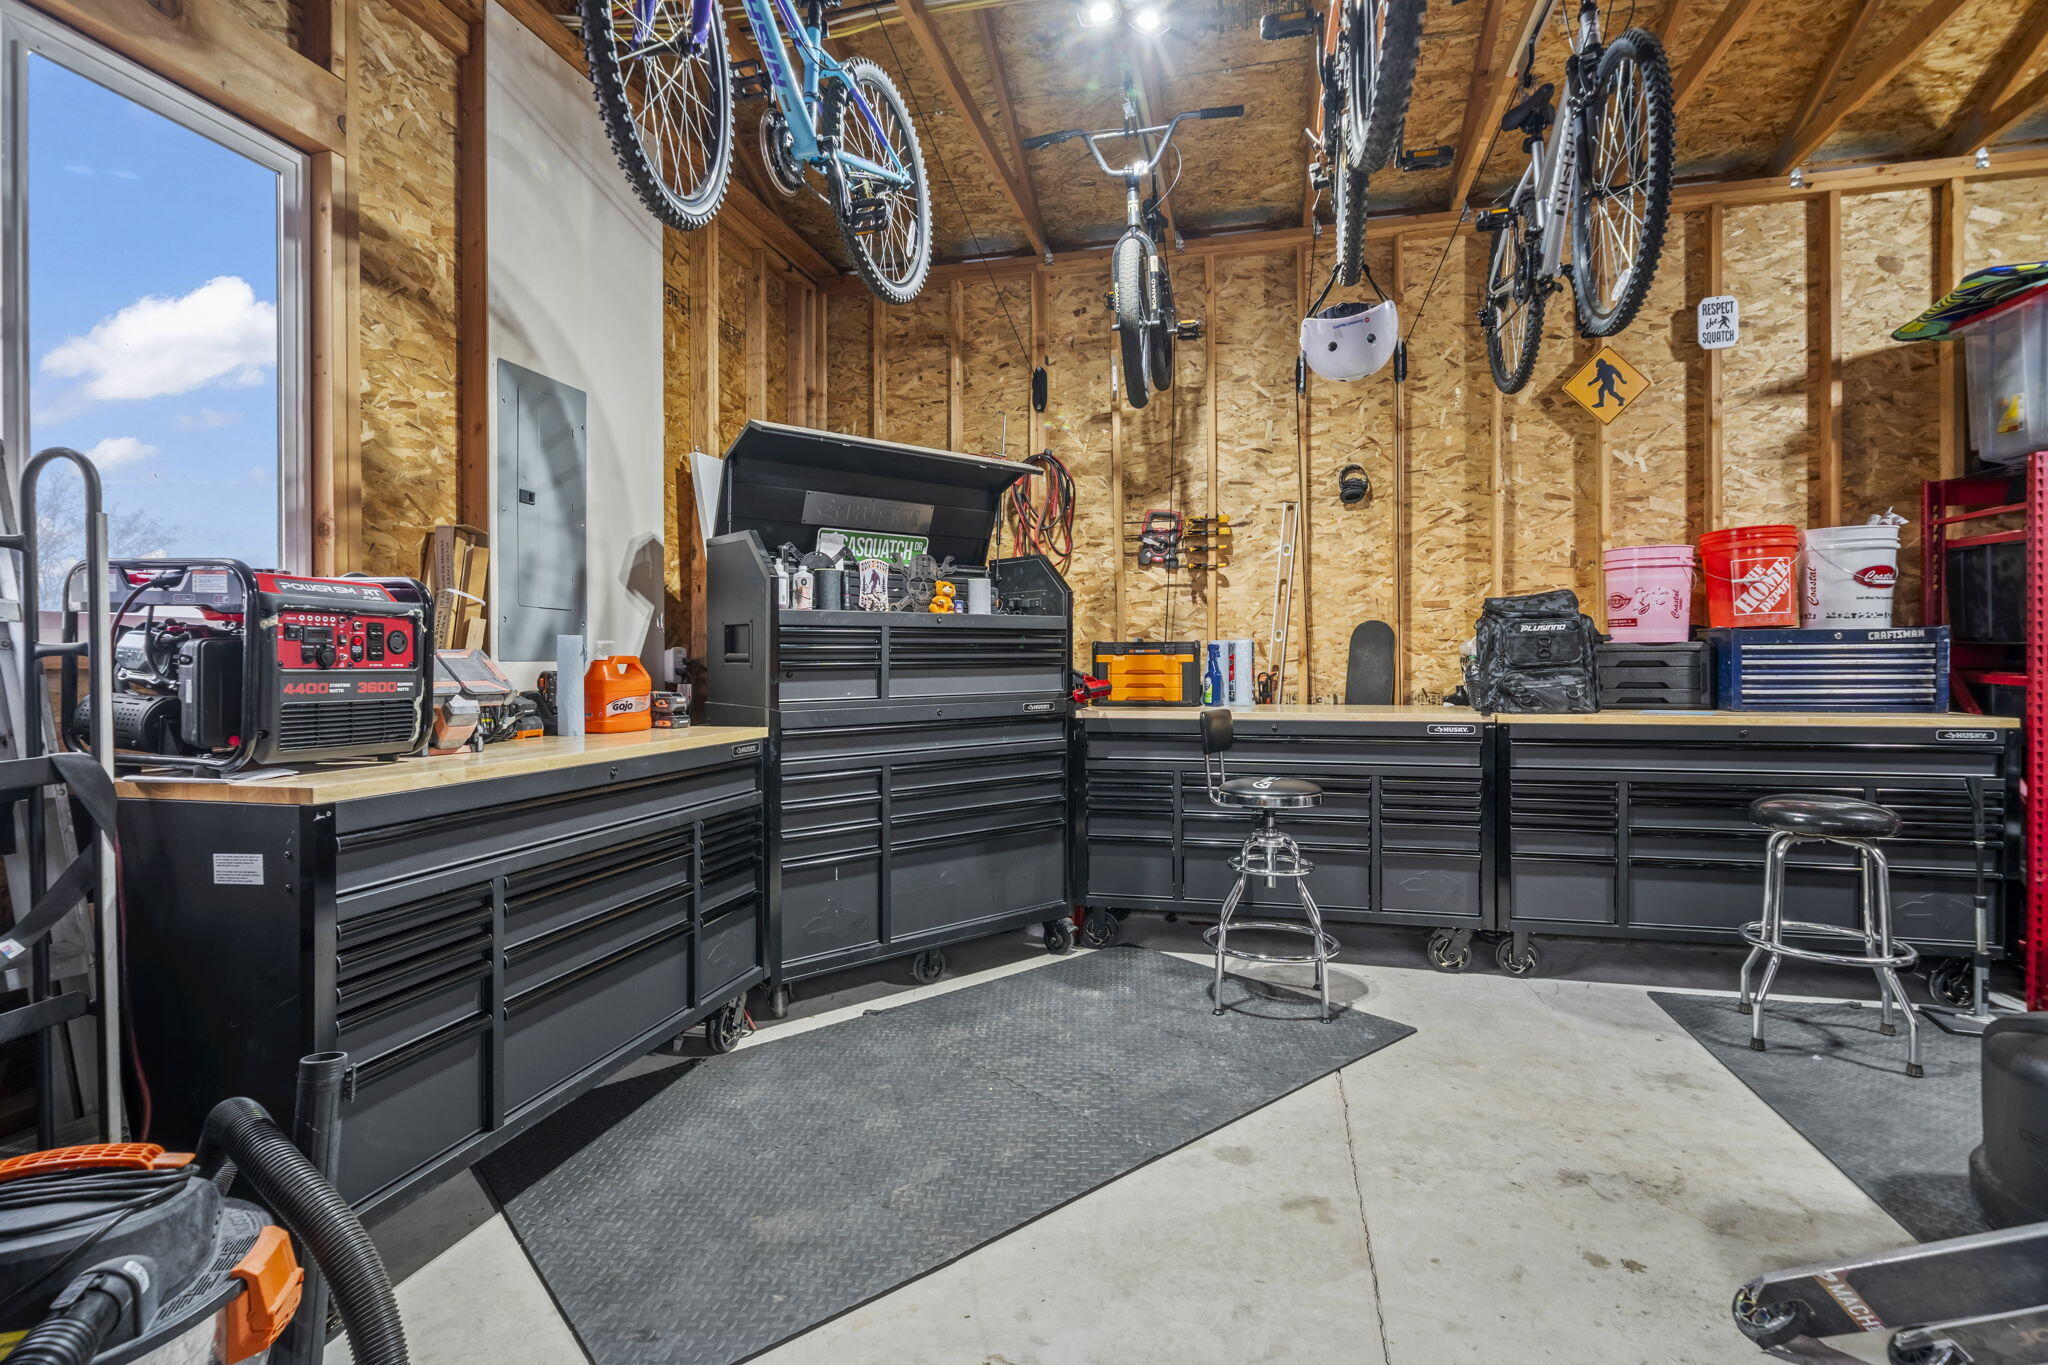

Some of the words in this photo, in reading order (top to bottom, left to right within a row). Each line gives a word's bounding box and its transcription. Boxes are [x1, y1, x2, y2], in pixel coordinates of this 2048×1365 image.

[1702, 300, 1735, 316] RESPECT
[1705, 317, 1718, 330] the
[1702, 329, 1735, 345] SQUATCH
[914, 541, 924, 552] DR
[1735, 558, 1790, 613] HOME
[1807, 565, 1819, 606] Coastal
[1758, 577, 1790, 613] DEPOT
[1671, 589, 1680, 619] Coastal
[1520, 624, 1566, 632] PLUSINNO
[1867, 629, 1925, 640] CRAFTSMAN
[283, 682, 329, 694] 4400
[357, 681, 397, 693] 3600
